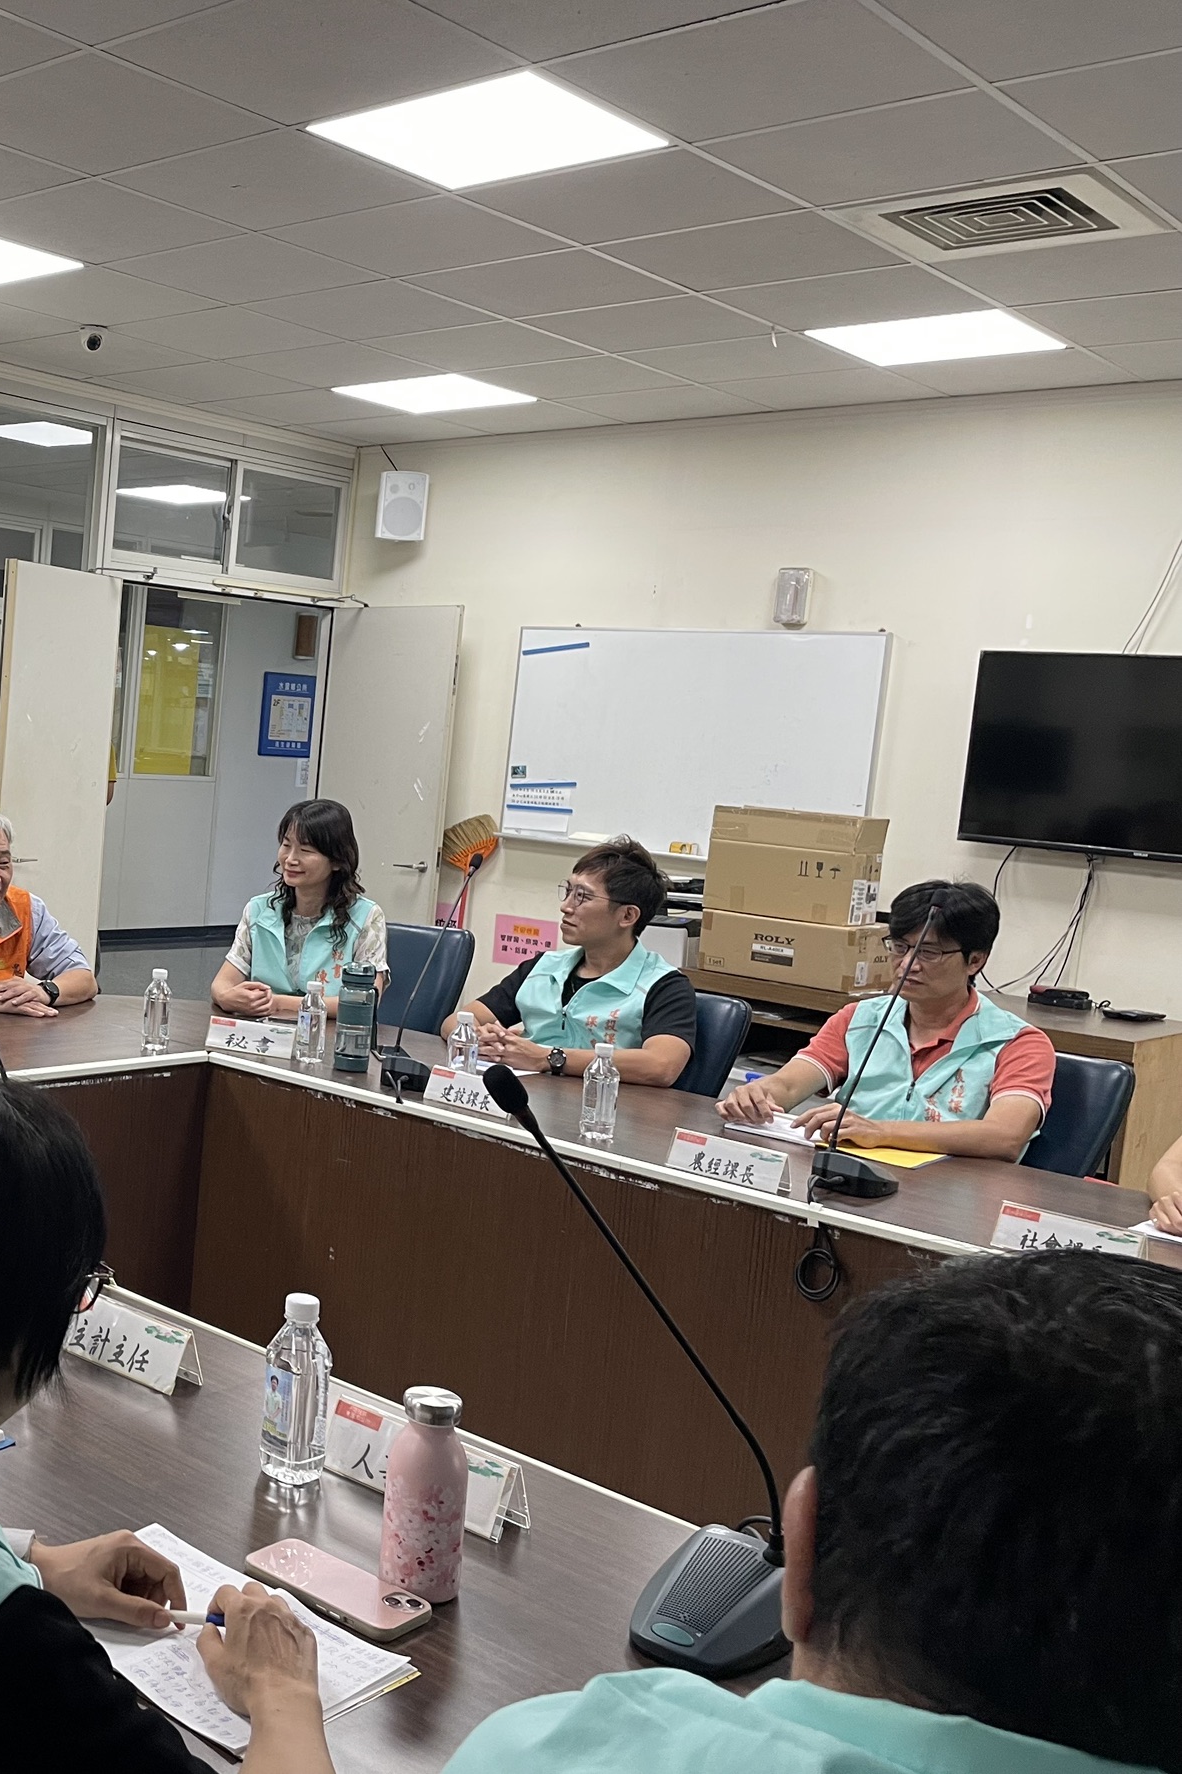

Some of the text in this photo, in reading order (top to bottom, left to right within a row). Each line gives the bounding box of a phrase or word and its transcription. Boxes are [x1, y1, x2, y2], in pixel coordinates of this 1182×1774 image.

[753, 933, 795, 945] ROLY
[225, 1033, 275, 1054] 秘書
[440, 1083, 492, 1112] 建設課長
[688, 1150, 755, 1185] 農經課長
[69, 1318, 150, 1373] 主計主任
